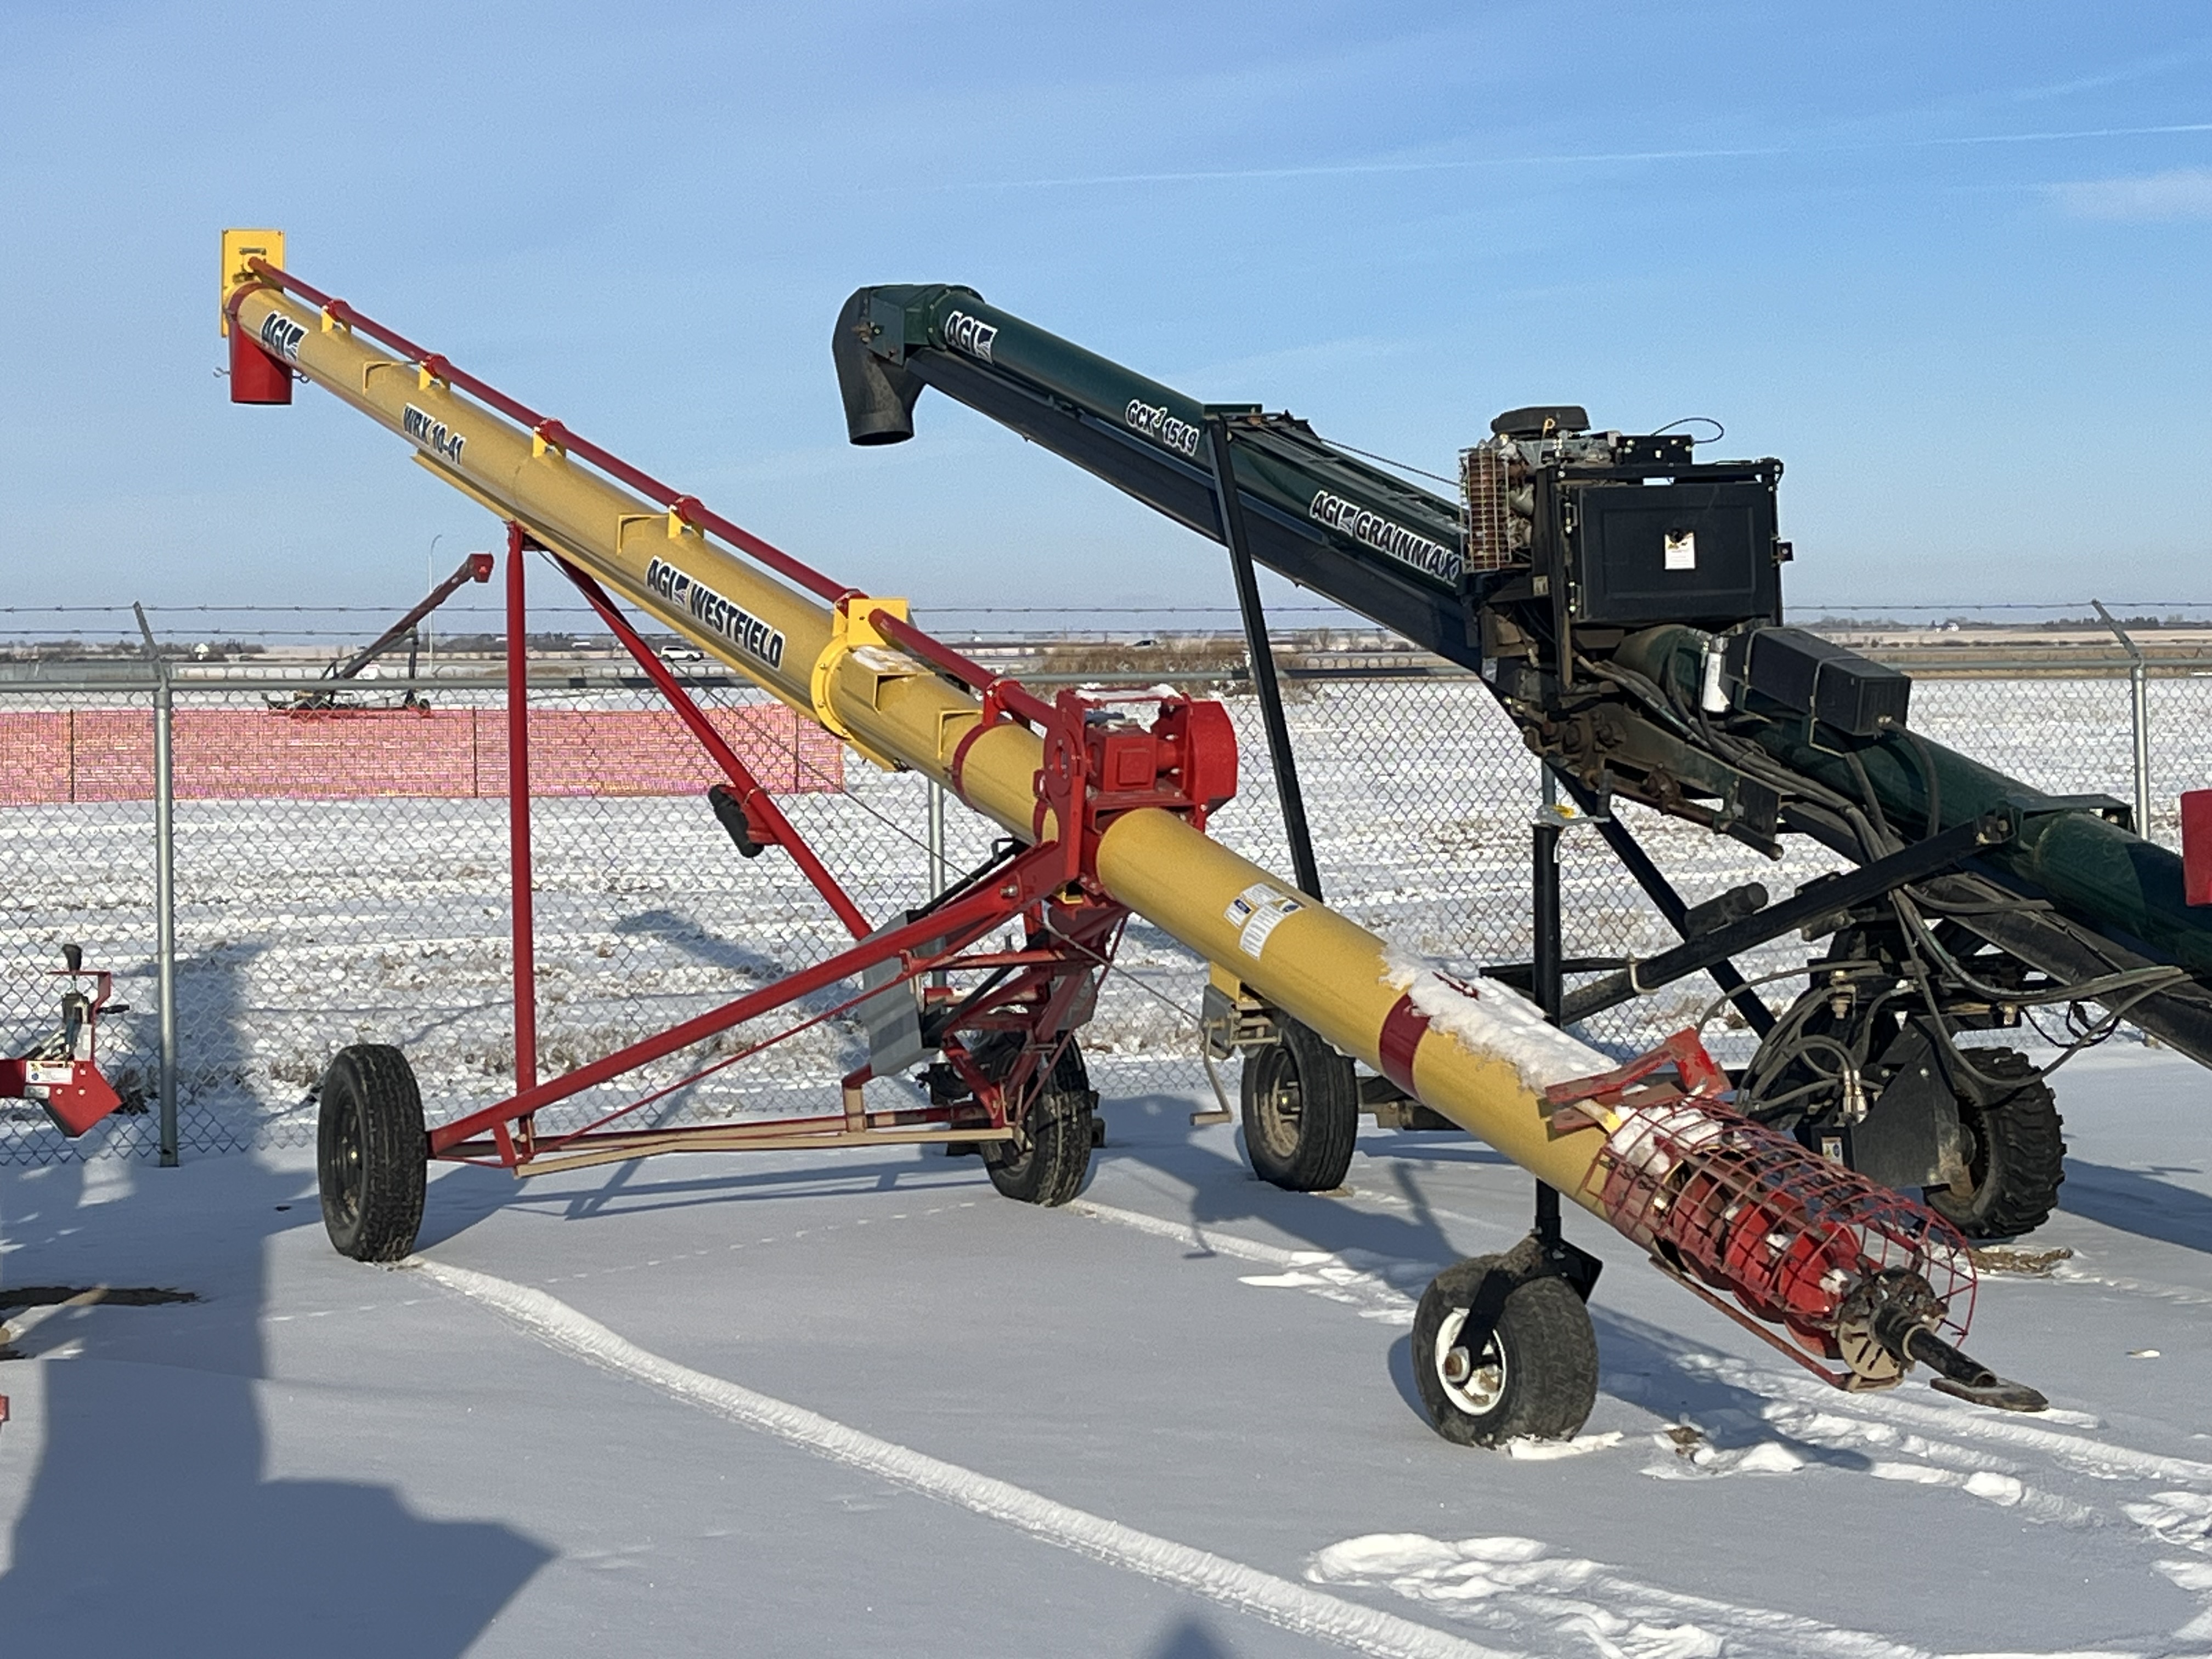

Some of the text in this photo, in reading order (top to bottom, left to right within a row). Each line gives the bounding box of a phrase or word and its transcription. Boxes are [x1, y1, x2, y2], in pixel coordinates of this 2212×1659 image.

[261, 312, 294, 360] AGI
[945, 312, 980, 357] AGI
[403, 404, 465, 465] WRX 10-41
[1164, 419, 1198, 454] 1549
[1312, 492, 1462, 584] AGI GRAINMAX
[646, 558, 784, 670] AGI WESTFIELD
